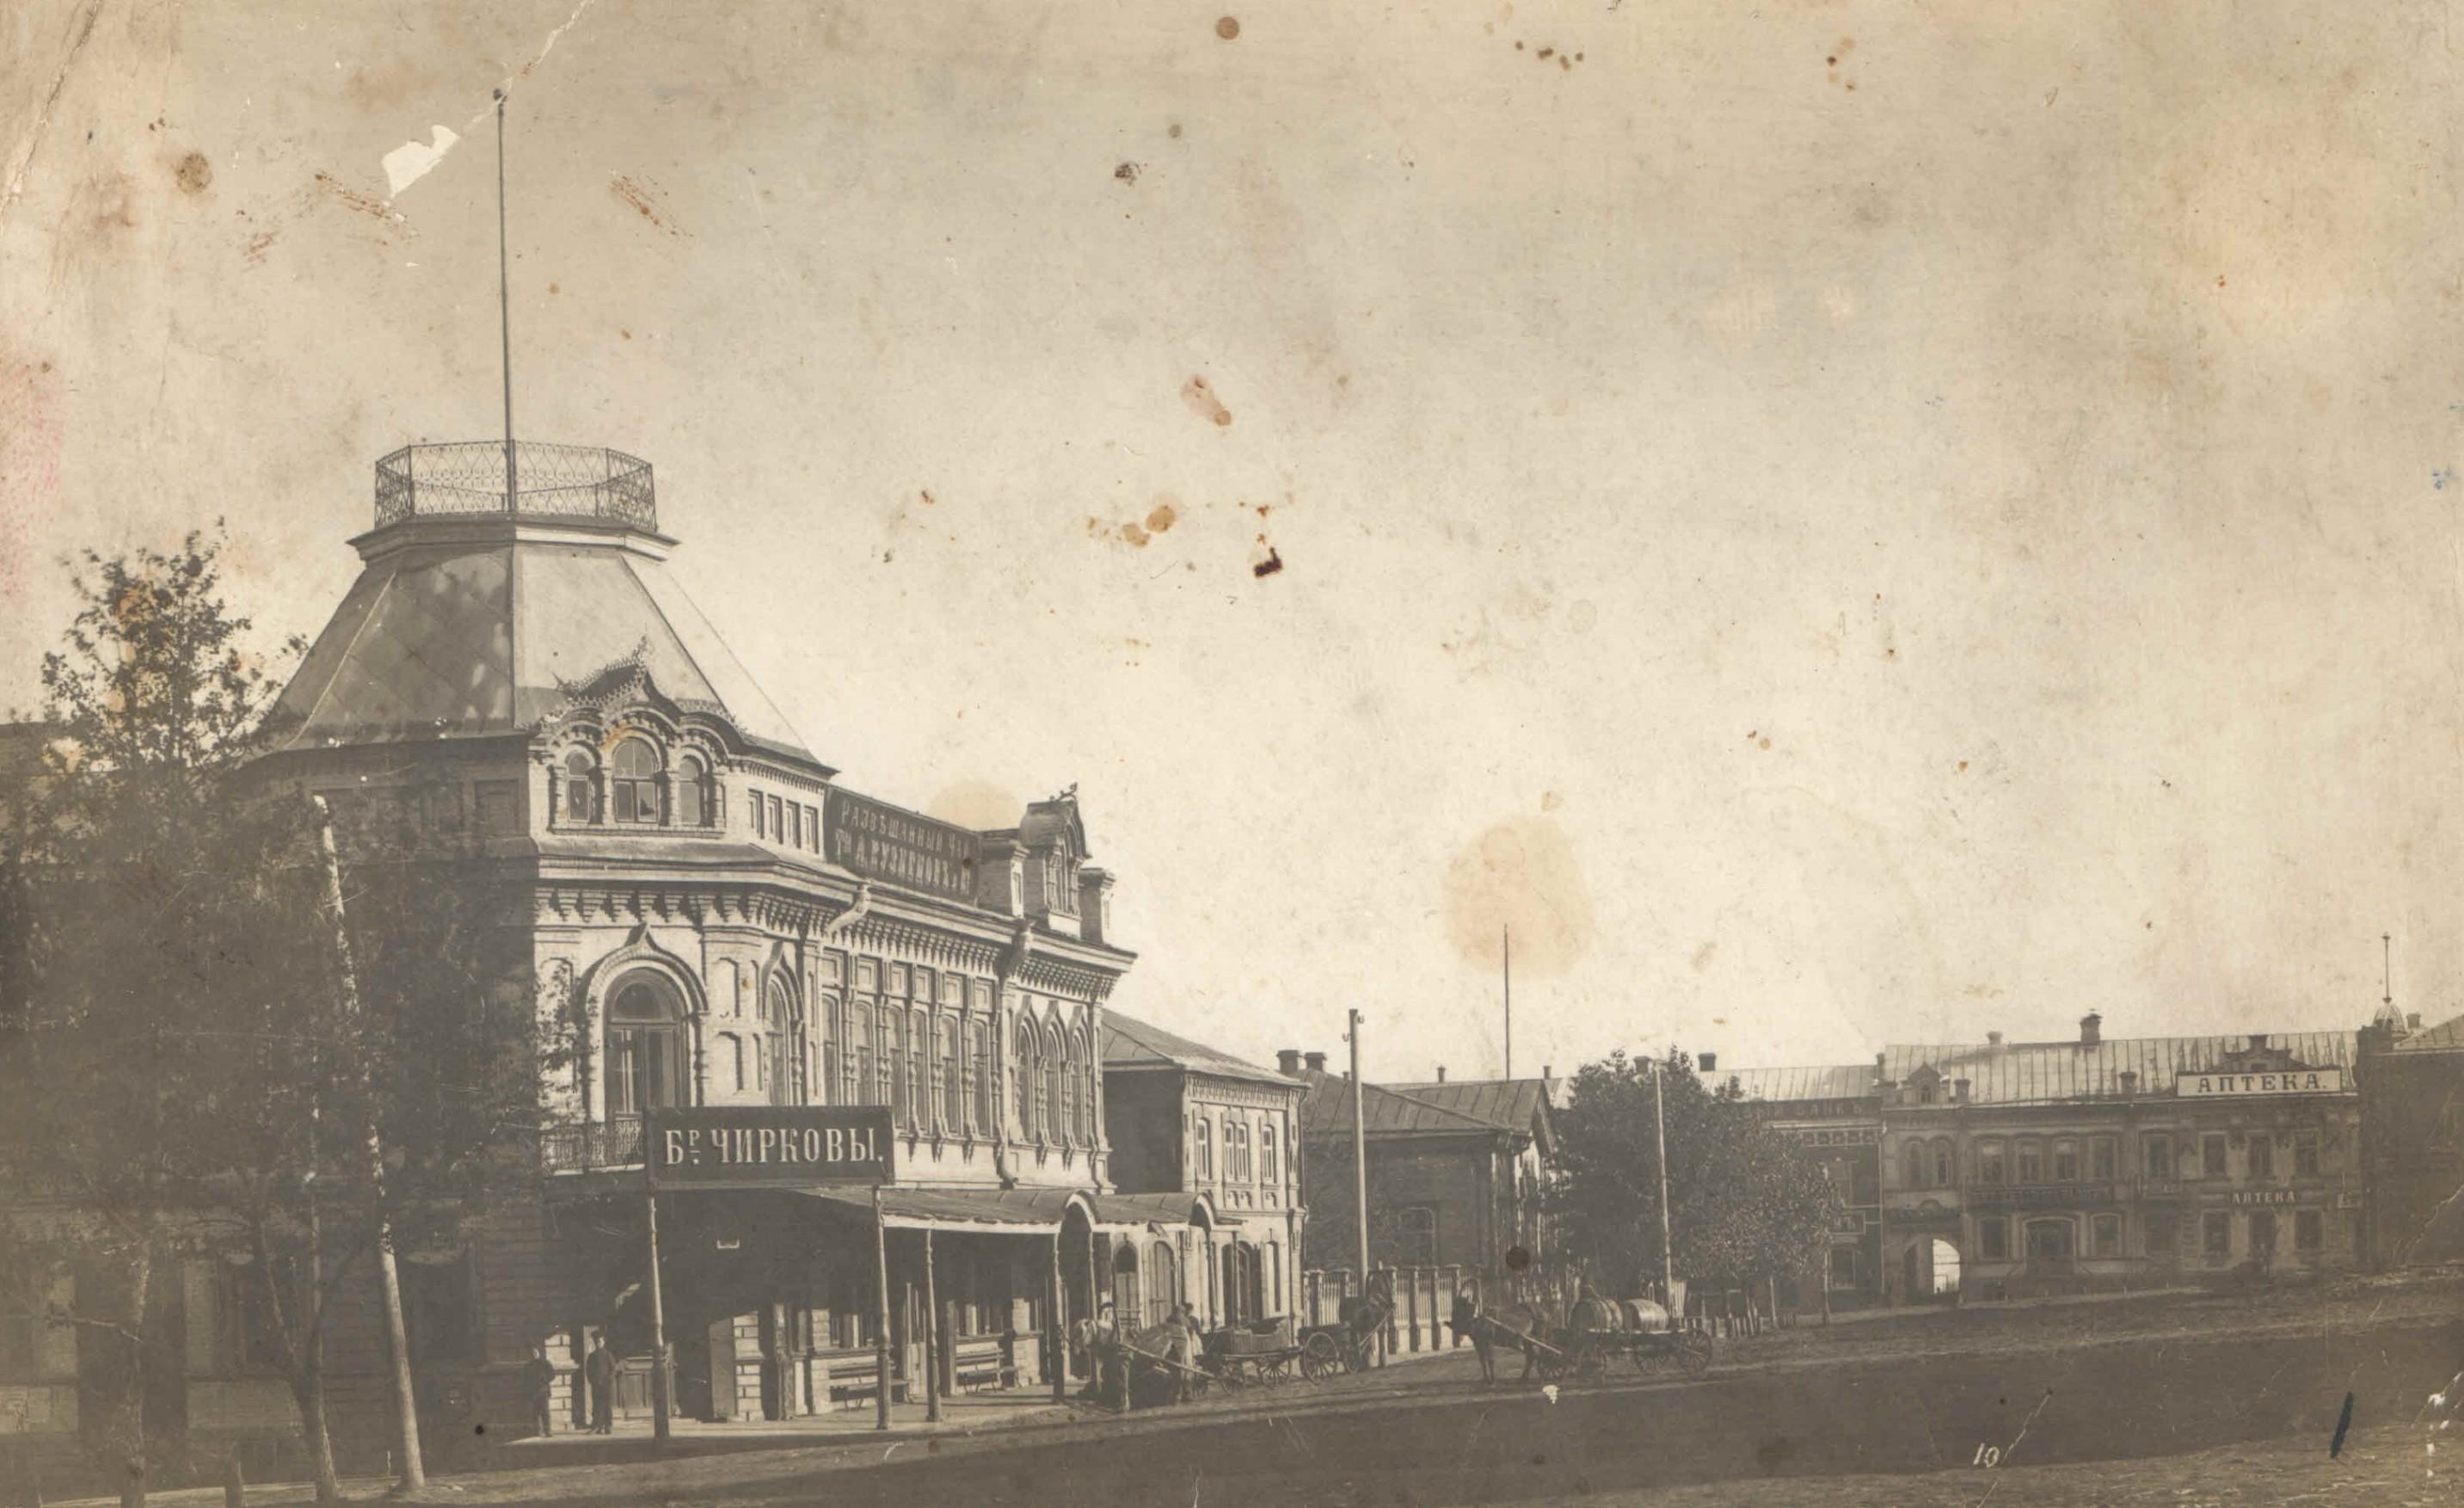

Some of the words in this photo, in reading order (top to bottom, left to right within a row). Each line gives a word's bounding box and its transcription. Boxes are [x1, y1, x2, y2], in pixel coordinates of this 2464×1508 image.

[2197, 1073, 2327, 1093] АПТЕКА.
[710, 1127, 884, 1163] ЧИРКОВЫ.
[2232, 1190, 2297, 1203] АПТЕКА
